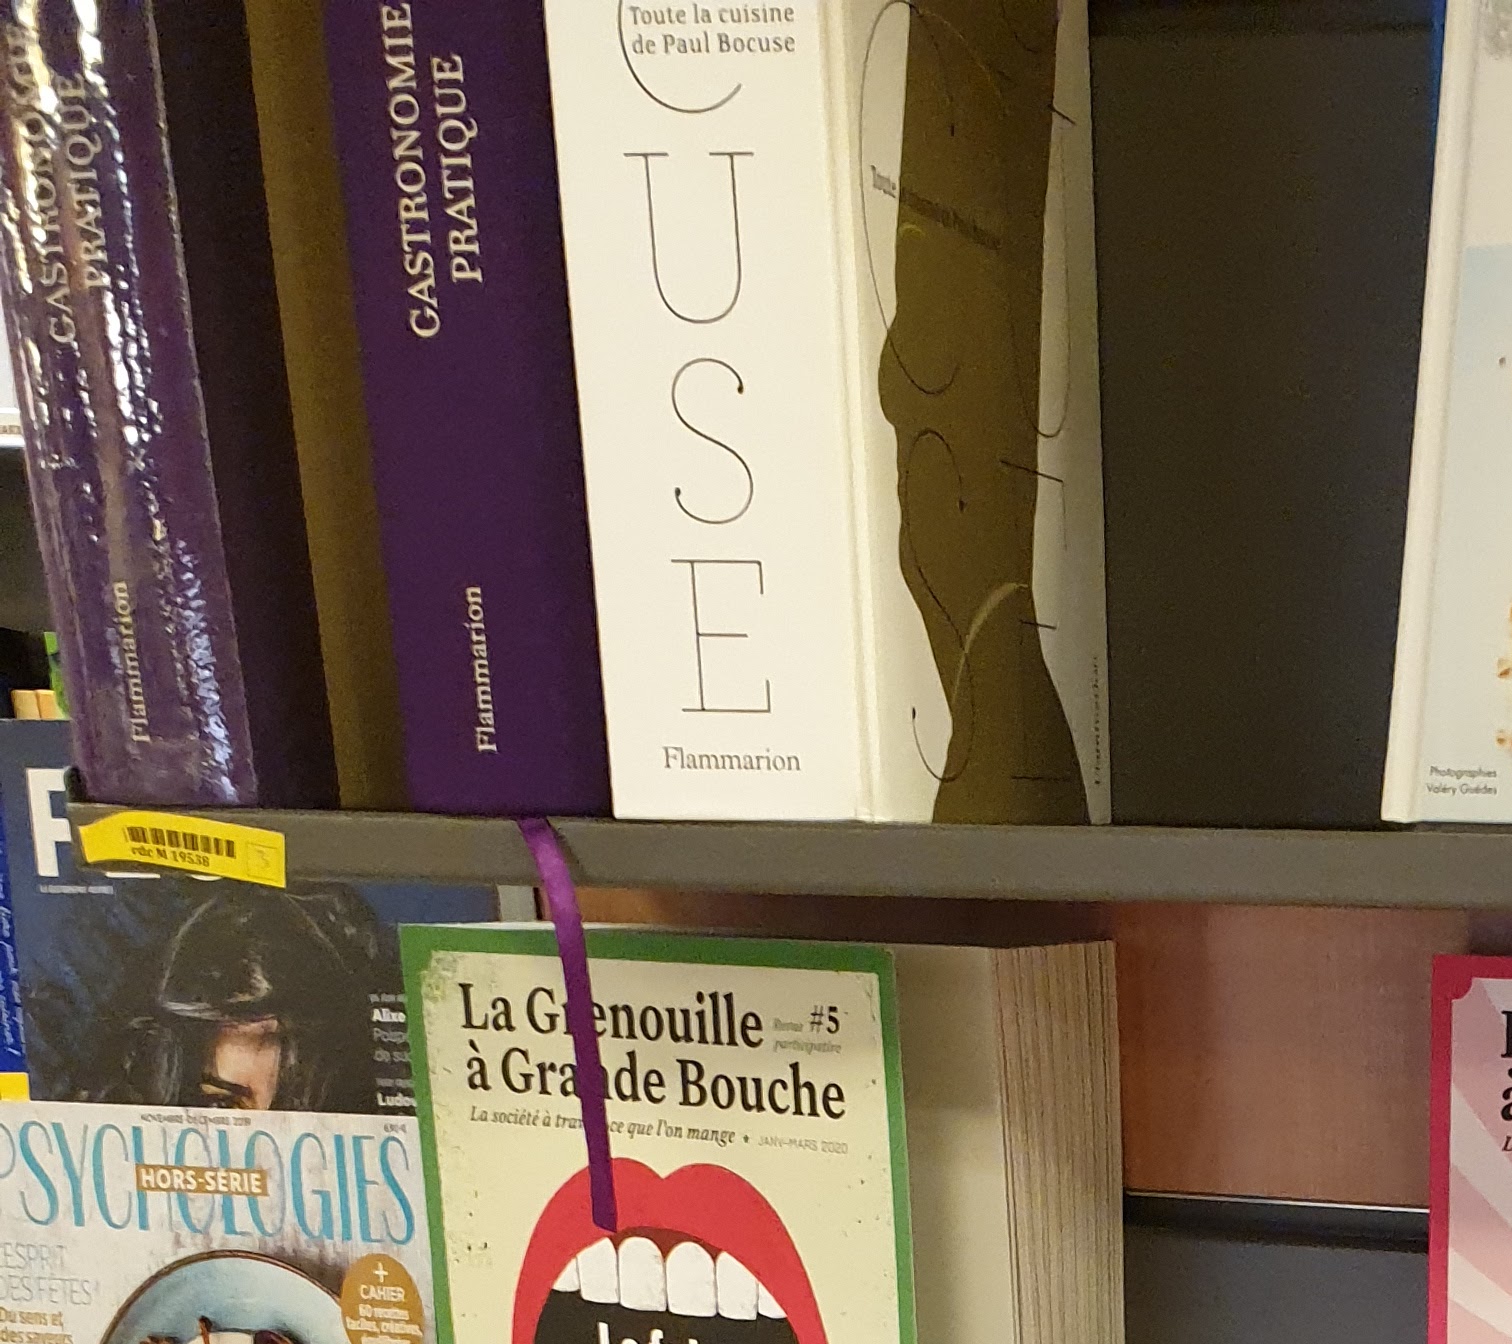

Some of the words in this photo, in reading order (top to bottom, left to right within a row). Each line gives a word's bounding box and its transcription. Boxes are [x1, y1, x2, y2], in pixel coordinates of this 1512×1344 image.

[629, 3, 682, 27] Toute
[689, 3, 708, 25] la
[715, 5, 795, 26] cuisine
[631, 33, 656, 55] de
[662, 31, 710, 54] Paul
[717, 32, 796, 54] Bocuse
[379, 3, 441, 339] GASTRONOMIE
[430, 53, 483, 283] PRATIQUE
[464, 588, 498, 754] Flammarion
[113, 580, 151, 744] Flammarion
[662, 745, 801, 773] Flammarion
[459, 982, 515, 1034] La
[810, 1005, 841, 1035] #5
[466, 1040, 491, 1091] à
[676, 1058, 846, 1120] Bouche
